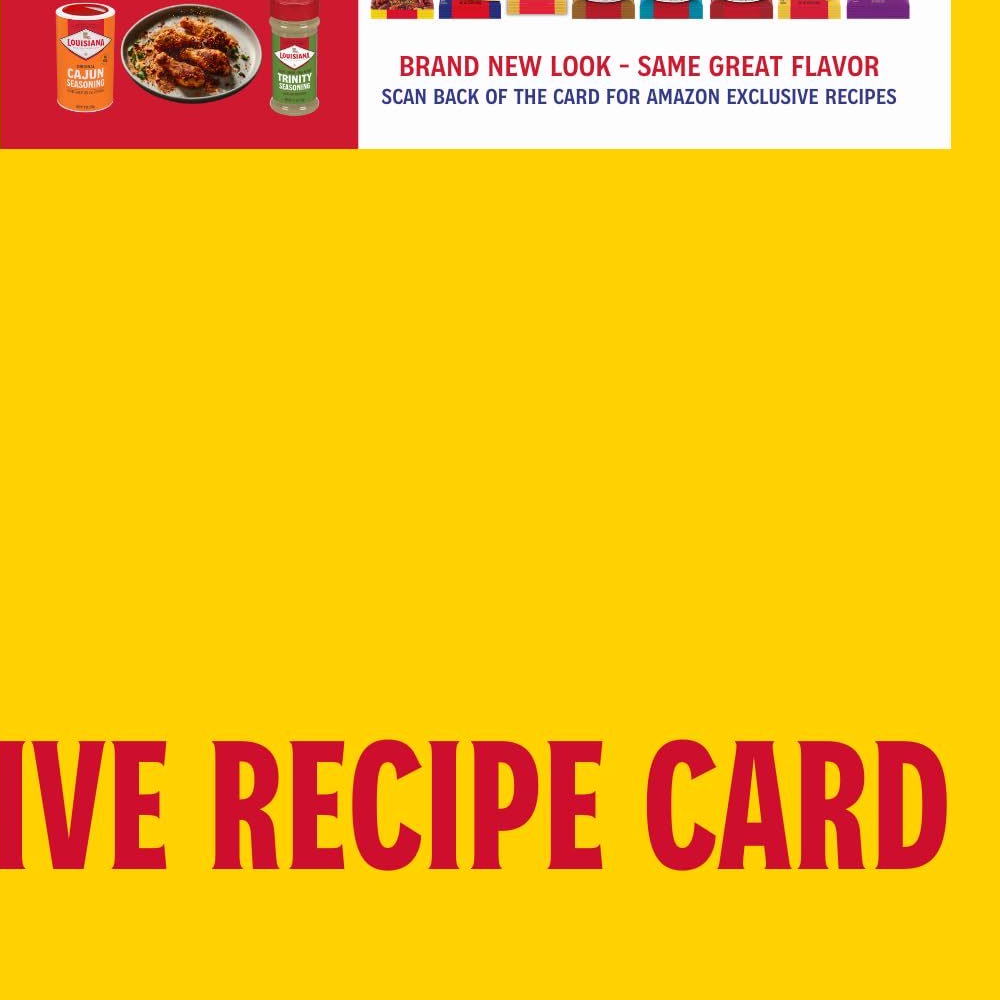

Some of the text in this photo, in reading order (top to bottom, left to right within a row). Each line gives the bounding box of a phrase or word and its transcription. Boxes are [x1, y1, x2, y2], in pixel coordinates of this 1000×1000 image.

[400, 56, 479, 76] BRAND
[489, 56, 542, 76] NEW
[552, 56, 611, 76] LOOK
[638, 56, 700, 76] SAME
[710, 56, 783, 76] GREAT
[792, 56, 878, 76] FLAVOR
[67, 68, 104, 80] CAJUN
[277, 72, 312, 83] TRINITY
[67, 79, 104, 88] SEASONING
[382, 89, 896, 104] SCAN BACK OF THE CARD FOR AMAZON EXCLUSIVE RECIPES
